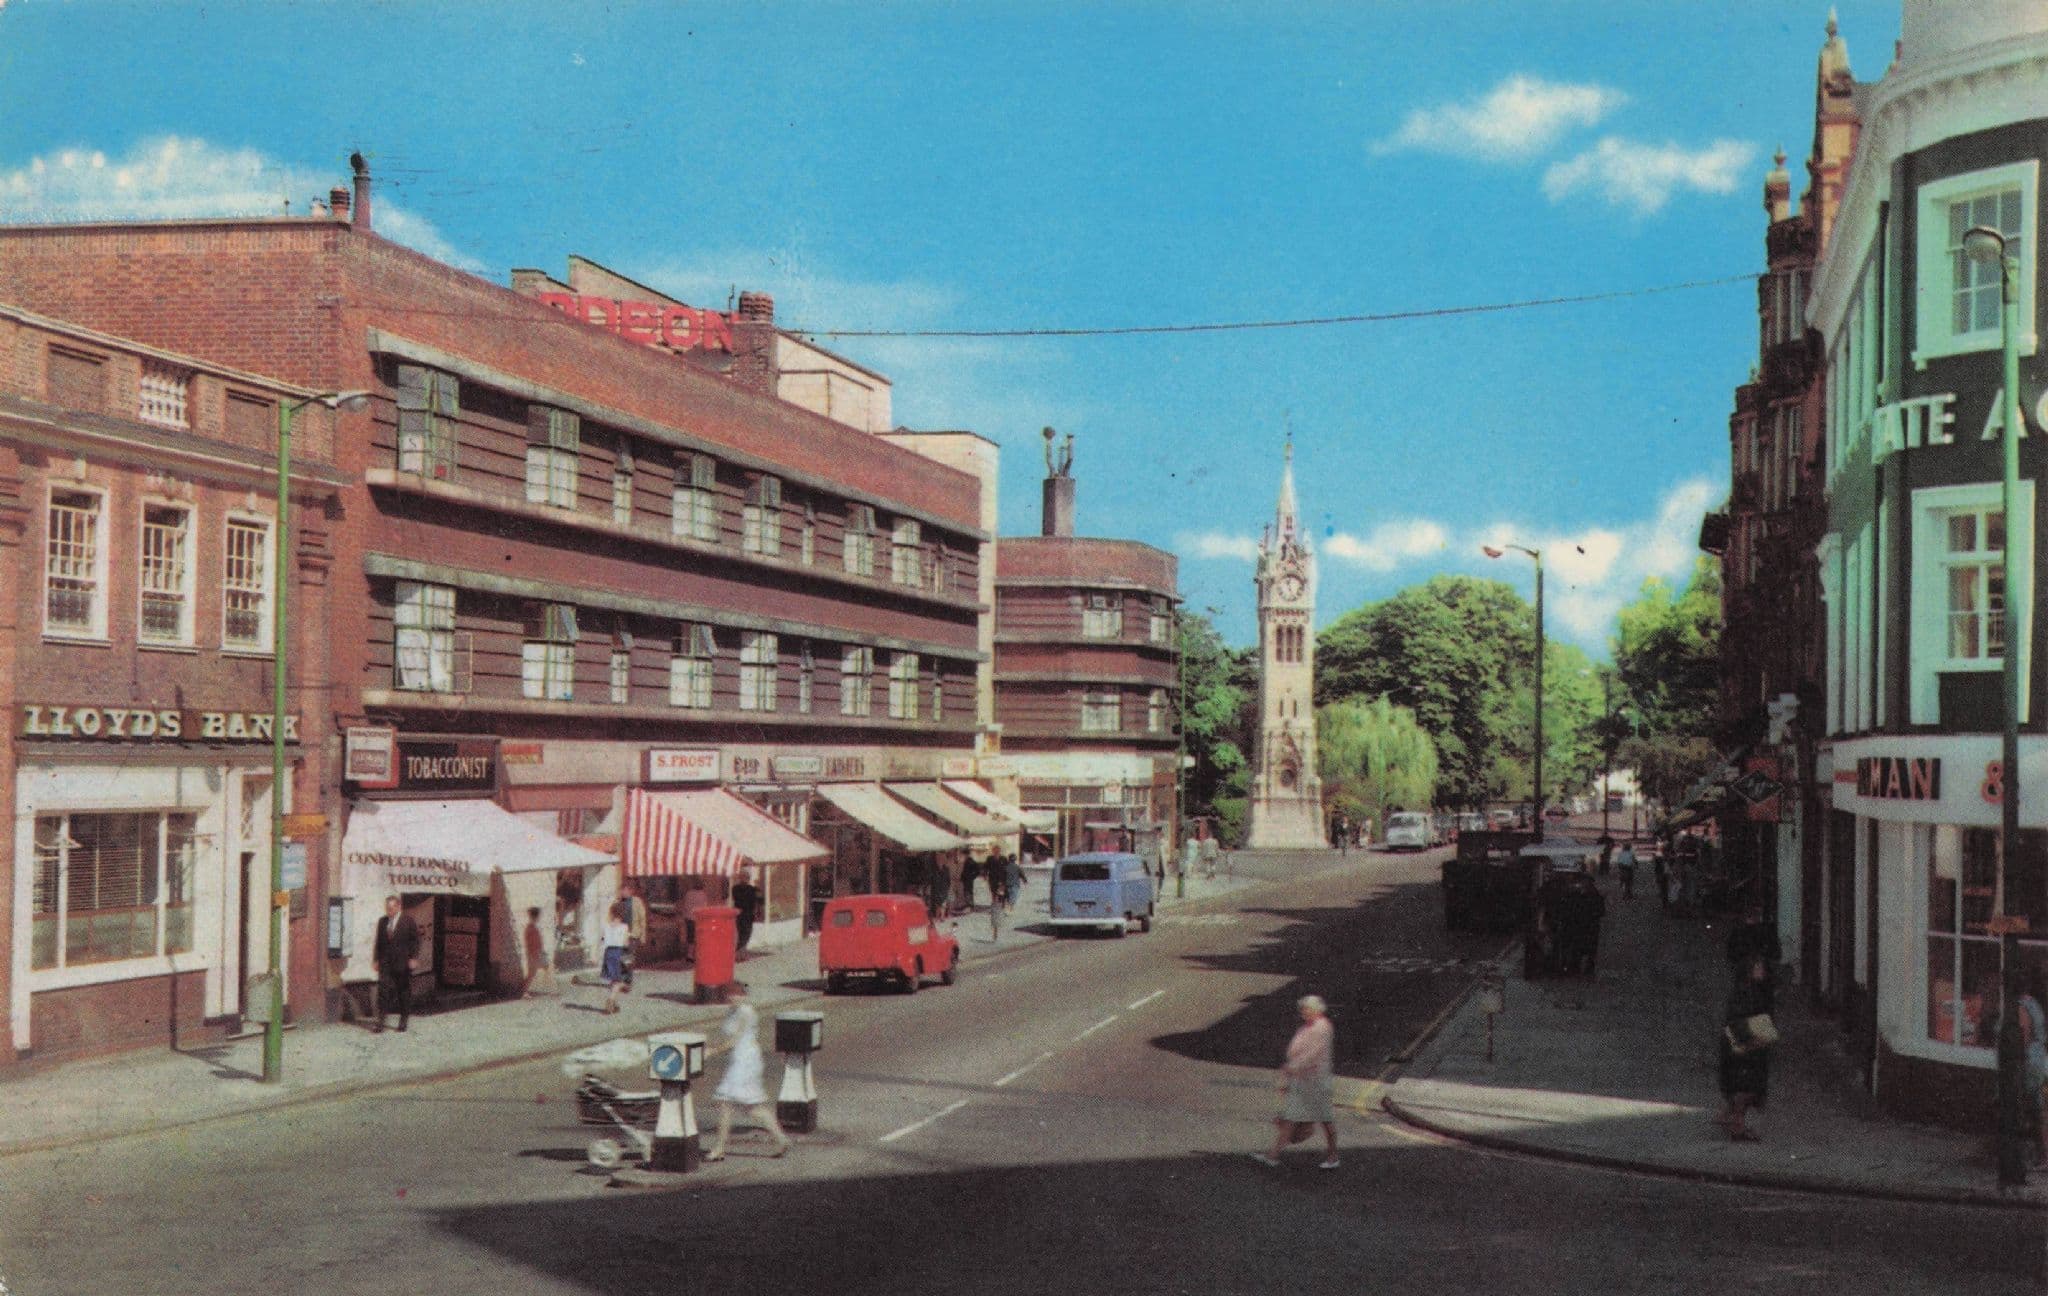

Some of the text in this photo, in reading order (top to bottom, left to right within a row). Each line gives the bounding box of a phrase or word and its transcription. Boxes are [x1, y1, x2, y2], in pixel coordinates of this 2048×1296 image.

[24, 705, 299, 740] LLOYDS BANK
[407, 756, 488, 779] TOBACCONIST
[1981, 761, 2005, 804] &
[388, 873, 459, 887] TOBACCO
